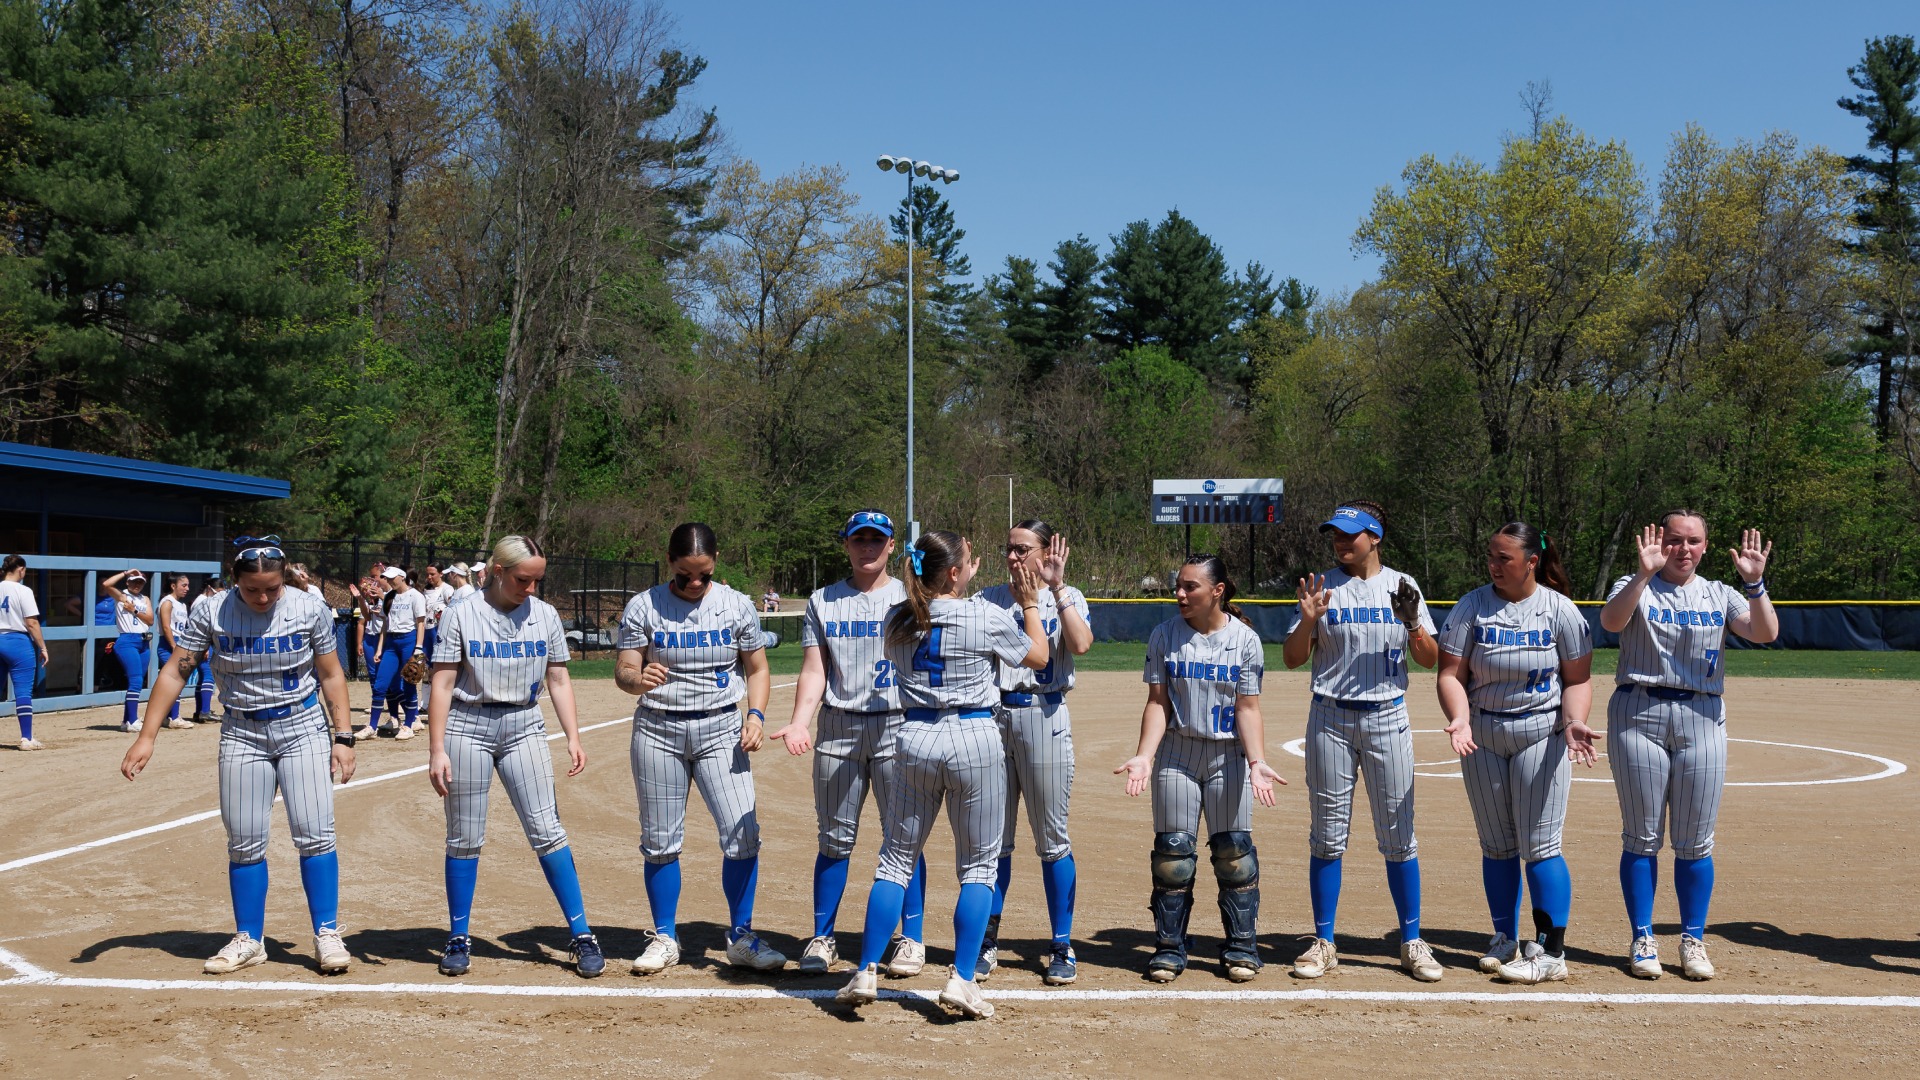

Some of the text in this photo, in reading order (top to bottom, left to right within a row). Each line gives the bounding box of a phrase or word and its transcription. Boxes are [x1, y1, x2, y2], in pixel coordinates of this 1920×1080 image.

[1155, 514, 1181, 522] RAIDERS
[1161, 506, 1180, 514] GUEST
[1647, 605, 1724, 627] RAIDERS
[218, 633, 303, 655] RAIDERS
[653, 628, 733, 649] RAIDERS
[1473, 625, 1552, 647] RAIDERS
[468, 639, 547, 659] RAIDERS
[912, 624, 946, 688] 4
[1164, 660, 1242, 683] RAIDERS
[1383, 648, 1402, 677] 17
[1705, 649, 1719, 678] 7
[282, 668, 300, 692] 6
[1525, 666, 1555, 694] 15
[1211, 704, 1236, 734] 16
